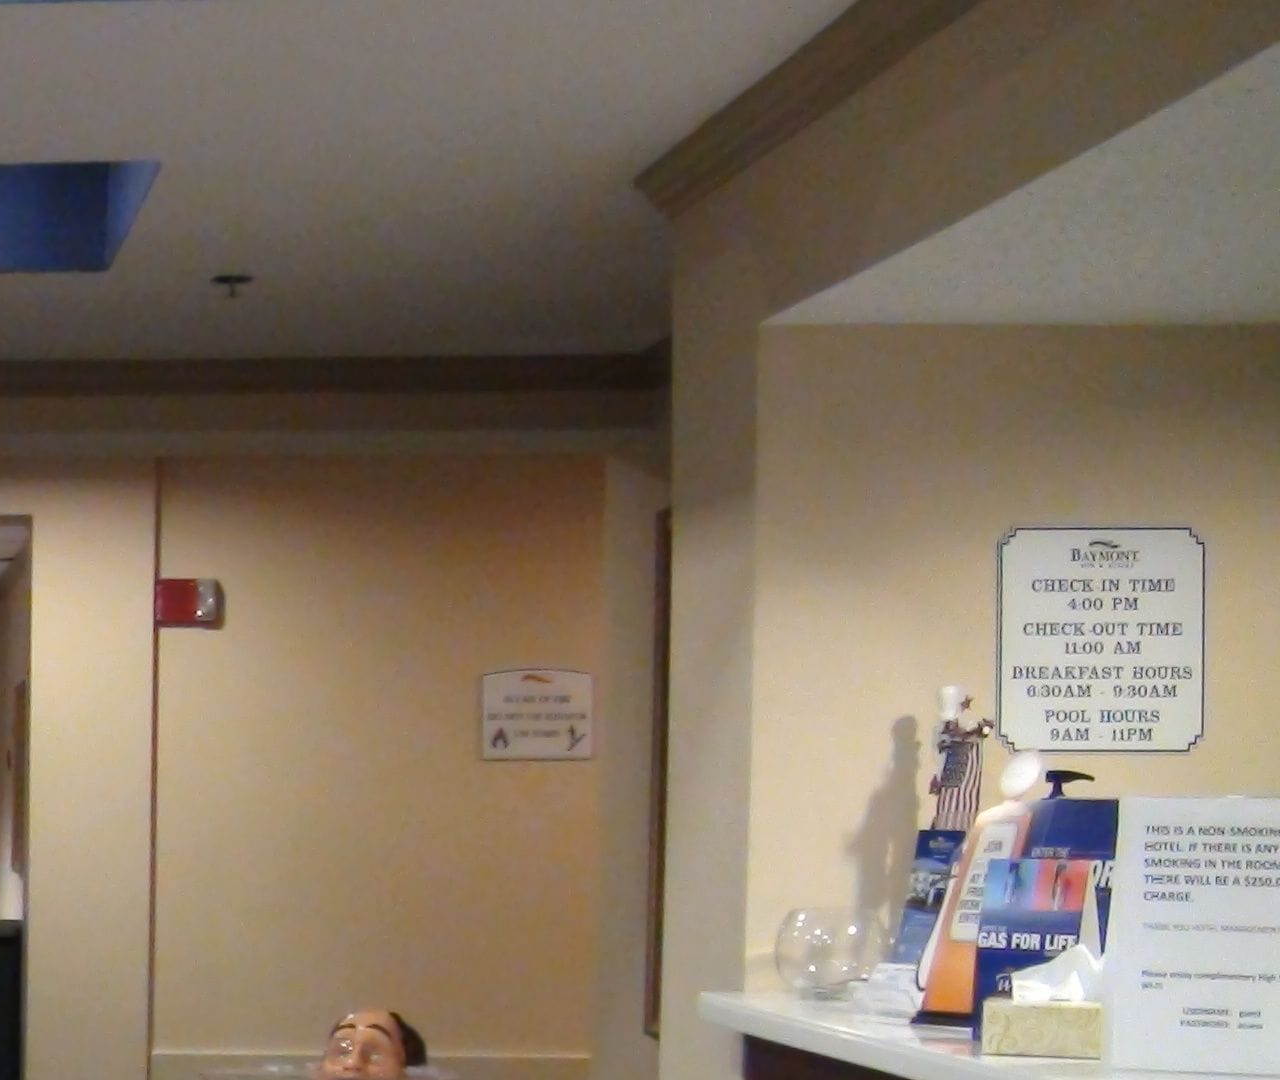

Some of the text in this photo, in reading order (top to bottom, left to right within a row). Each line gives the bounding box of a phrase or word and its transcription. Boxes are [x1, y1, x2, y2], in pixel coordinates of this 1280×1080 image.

[1070, 548, 1139, 561] BAYMONT
[1129, 578, 1176, 592] TIME
[1112, 598, 1139, 611] PM
[1137, 622, 1184, 636] TIME
[1114, 641, 1142, 654] AM
[1012, 666, 1193, 680] BREAKFAST HOURS
[1044, 709, 1160, 723] POOL HOURS
[1050, 728, 1090, 741] 9AM
[1112, 728, 1153, 741] 11PM
[1144, 826, 1170, 836] THIS
[1173, 826, 1184, 836] IS
[1186, 826, 1195, 836] A
[1202, 843, 1238, 853] THERE
[1242, 843, 1252, 853] IS
[1255, 843, 1279, 854] ANY
[1144, 858, 1201, 869] SMOKING
[1204, 860, 1217, 869] IN
[1220, 860, 1242, 870] THE
[1144, 874, 1180, 885] THERE
[1184, 875, 1212, 886] WILL
[1215, 876, 1229, 886] BE
[1231, 876, 1241, 886] A
[978, 932, 1077, 951] GAS FOR LIFE
